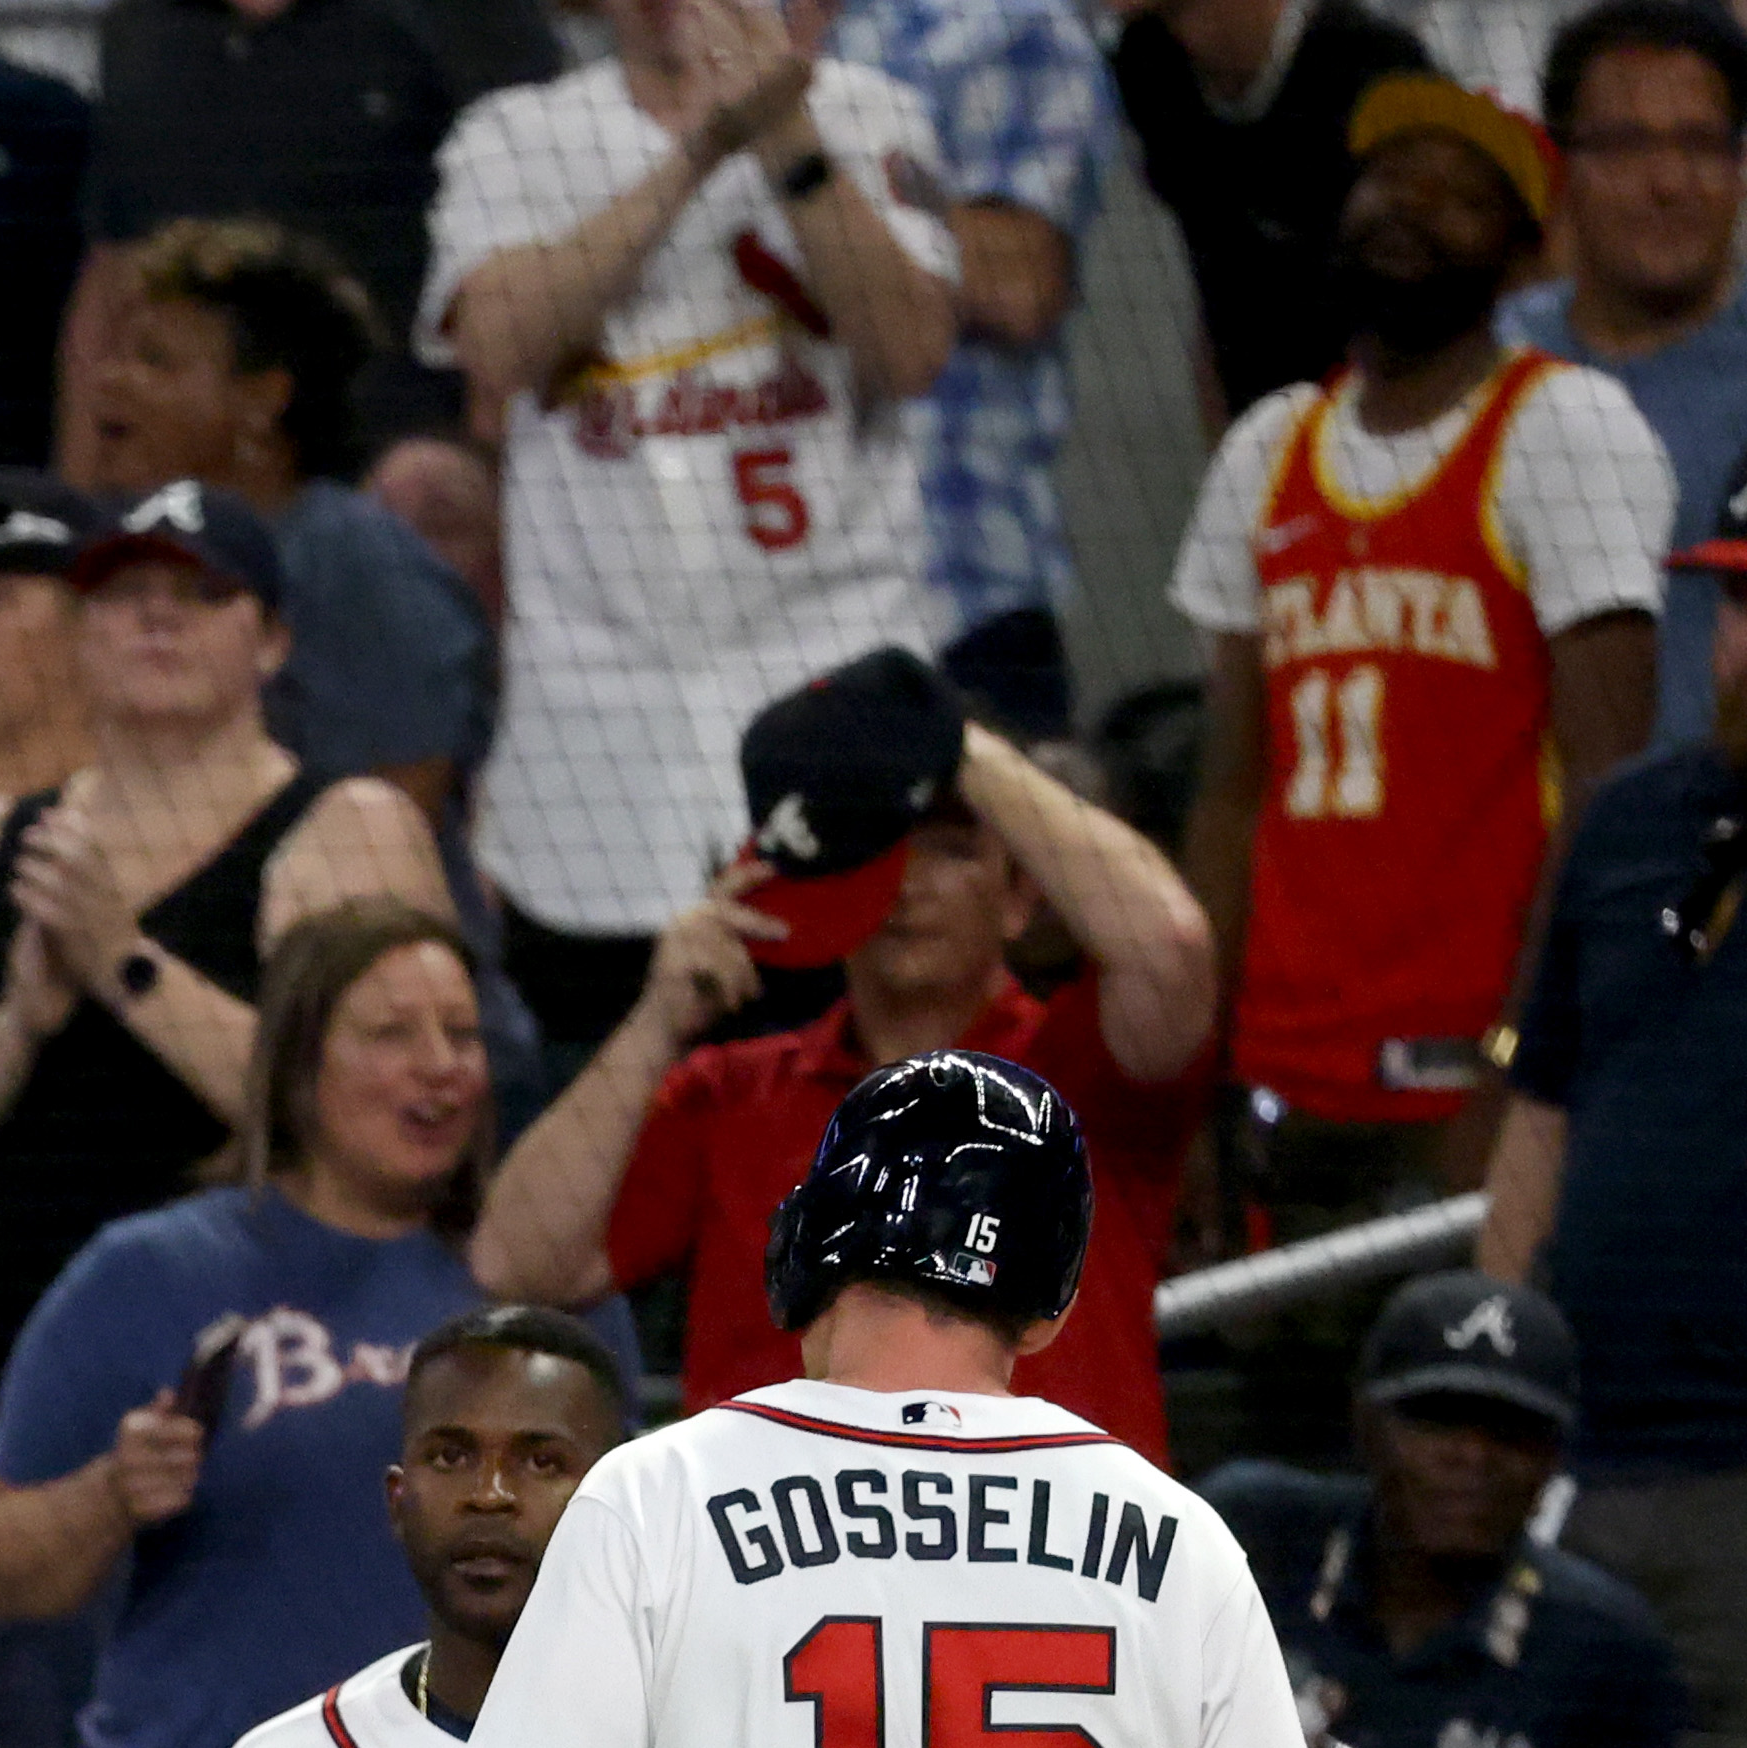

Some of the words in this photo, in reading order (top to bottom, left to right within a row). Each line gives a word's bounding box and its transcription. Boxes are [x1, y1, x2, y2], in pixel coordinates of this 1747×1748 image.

[733, 448, 809, 552] 5
[1285, 664, 1387, 820] 11
[964, 1212, 1001, 1254] 15
[706, 1468, 1178, 1603] GOSSELIN
